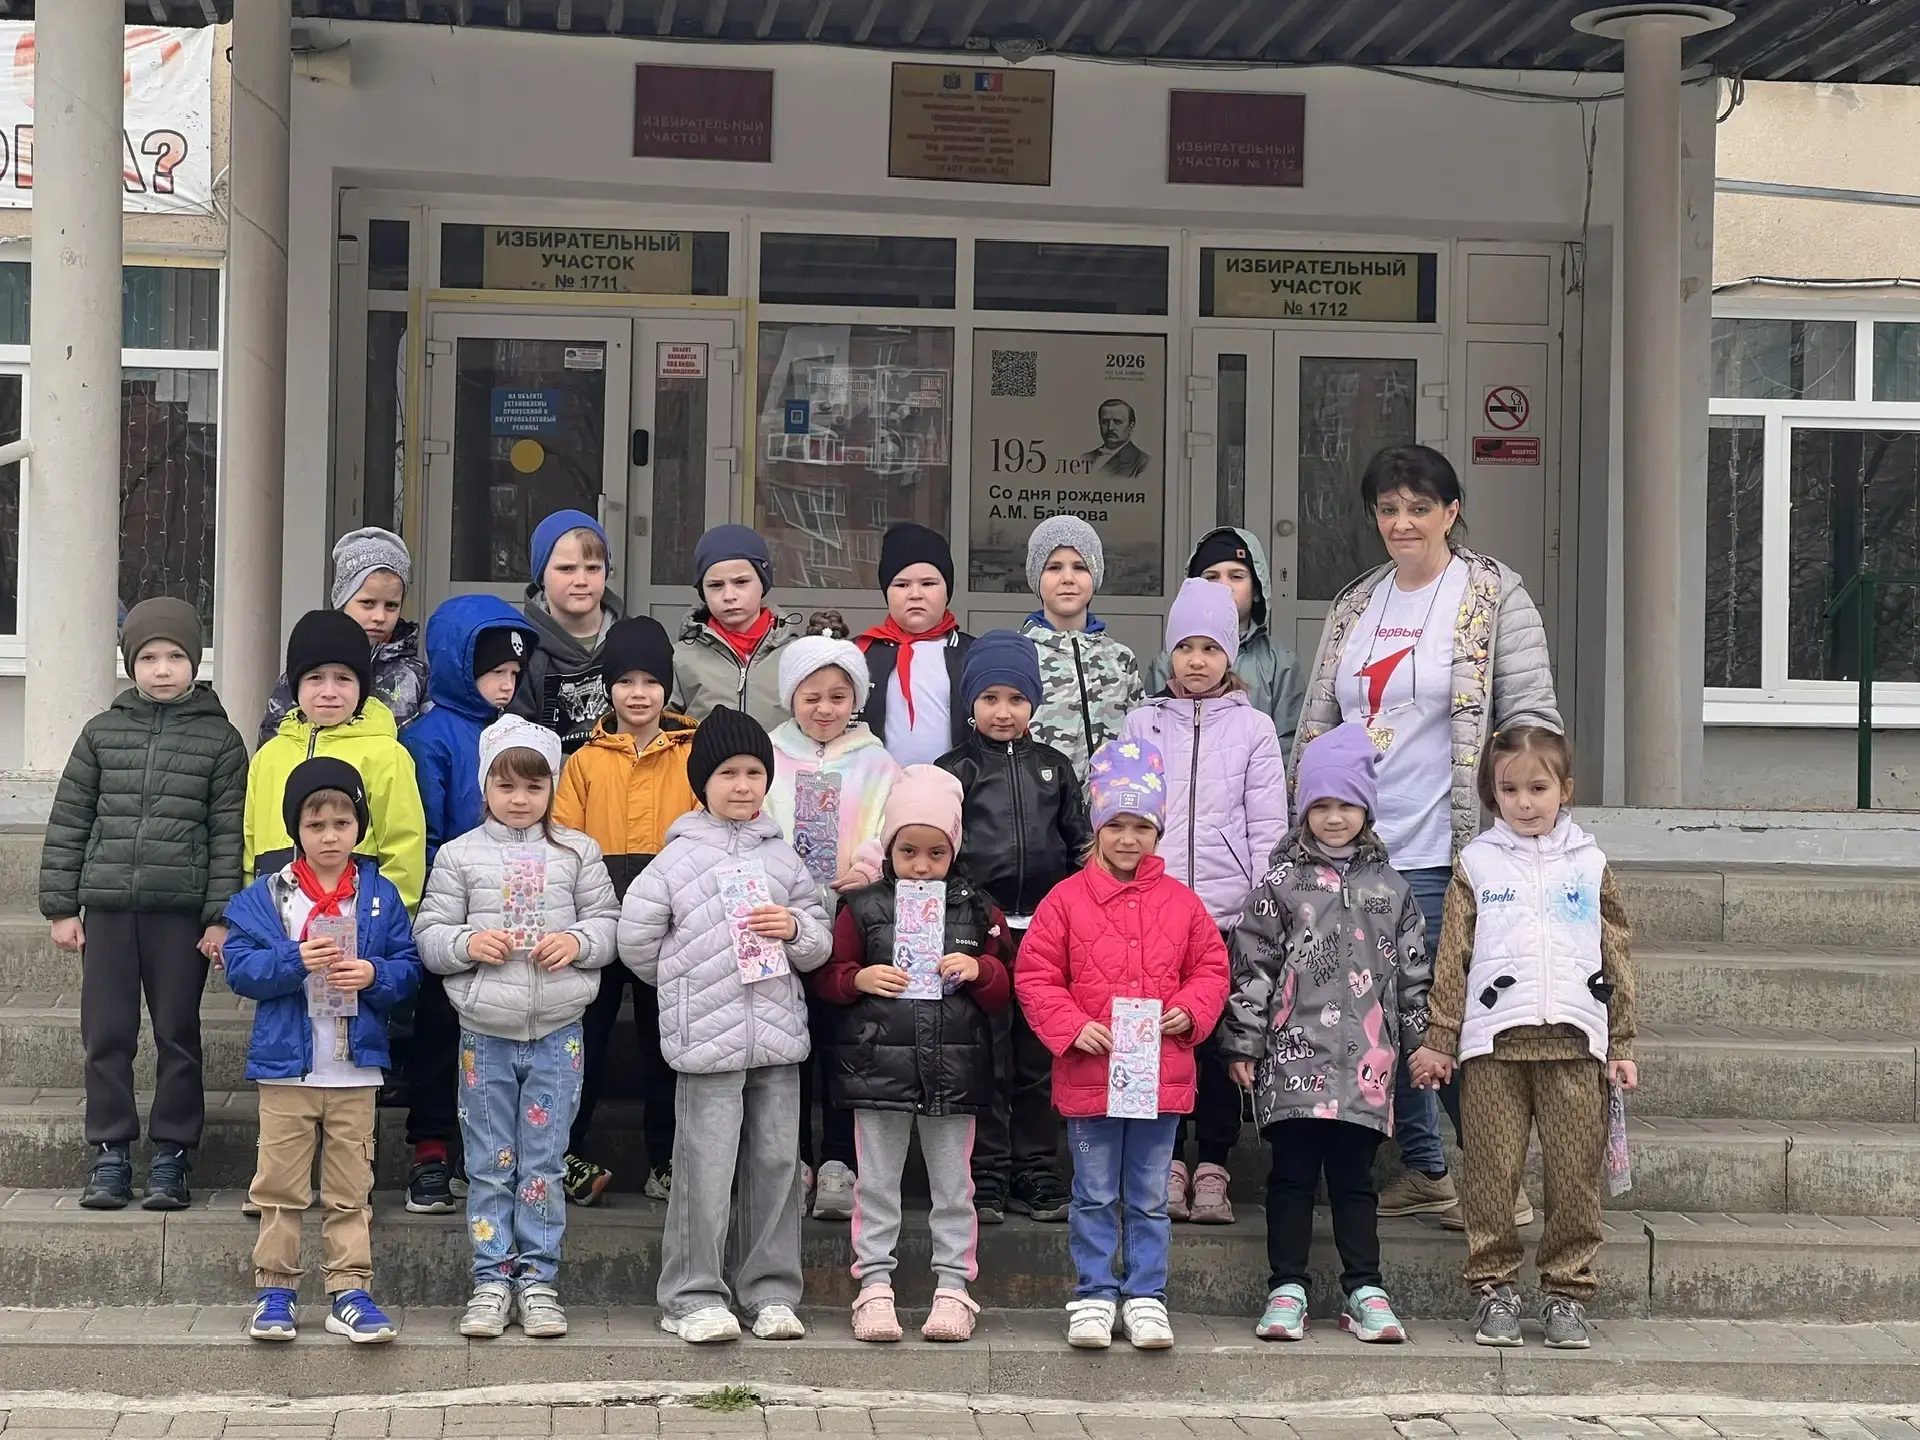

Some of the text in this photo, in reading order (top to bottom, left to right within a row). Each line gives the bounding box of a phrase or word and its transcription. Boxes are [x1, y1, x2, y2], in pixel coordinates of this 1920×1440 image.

[643, 115, 764, 131] ИЗБИРАТЕЛЬНЫЙ
[643, 132, 707, 144] УЧАСТОК
[714, 135, 728, 145] №
[1177, 141, 1296, 156] ИЗБИРАТЕЛЬНЫЙ
[1177, 155, 1296, 170] УЧАСТОК № 1712
[496, 230, 681, 251] ИЗБИРАТЕЛЬНЫЙ
[541, 253, 635, 271] УЧАСТОК
[1226, 257, 1406, 277] ИЗБИРАТЕЛЬНЫЙ
[555, 274, 618, 290] № 1711
[1270, 279, 1362, 296] УЧАСТОК
[1284, 300, 1348, 317] № 1712
[1105, 353, 1146, 369] 2026
[990, 438, 1094, 475] 195 лет
[988, 485, 1146, 504] Со дня рождения
[988, 504, 1027, 519] А.М.
[1482, 888, 1516, 904] Sochi
[1254, 898, 1280, 918] LOV
[1304, 931, 1341, 968] ANIMA
[1277, 1039, 1316, 1065] CLUB
[1284, 1075, 1326, 1092] LOVE
